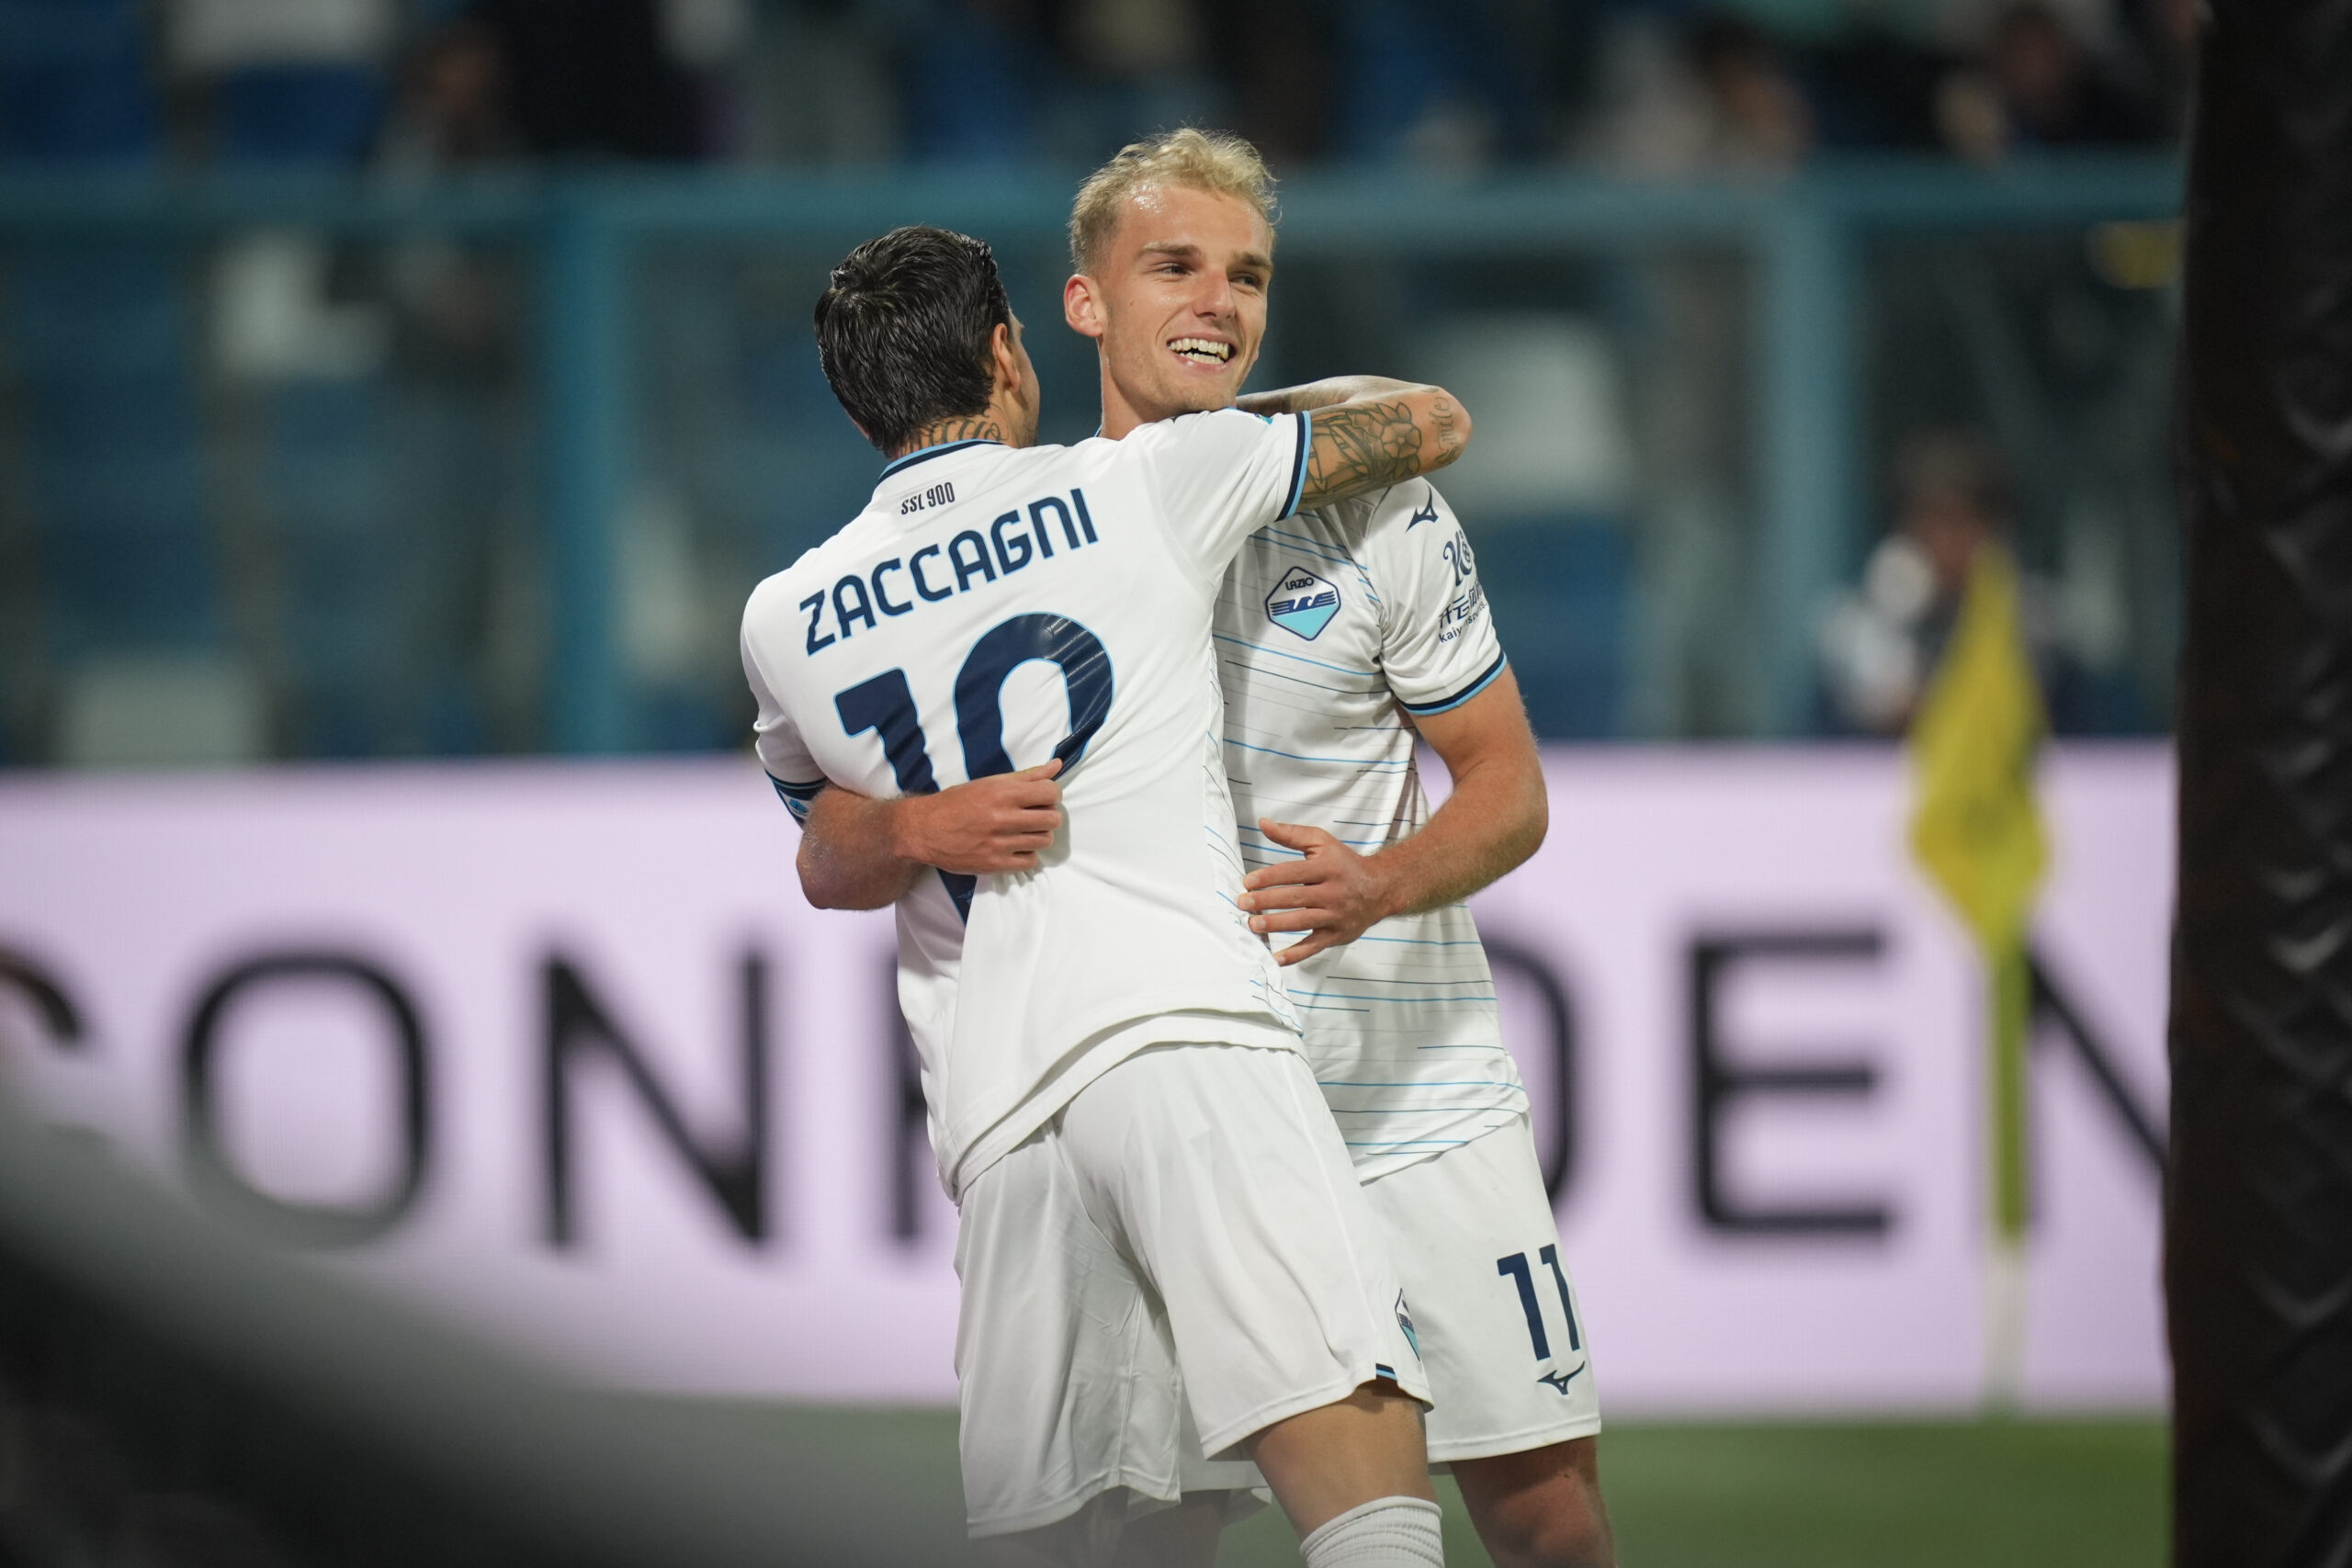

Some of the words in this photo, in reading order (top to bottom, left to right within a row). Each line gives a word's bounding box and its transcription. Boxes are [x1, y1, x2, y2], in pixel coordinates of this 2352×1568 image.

[901, 493, 925, 515] SSL
[926, 482, 956, 507] 900
[799, 488, 1099, 656] ZACCAGNI
[1285, 577, 1315, 591] LAZIO
[834, 611, 1114, 927] 10
[1497, 1243, 1580, 1361] 11
